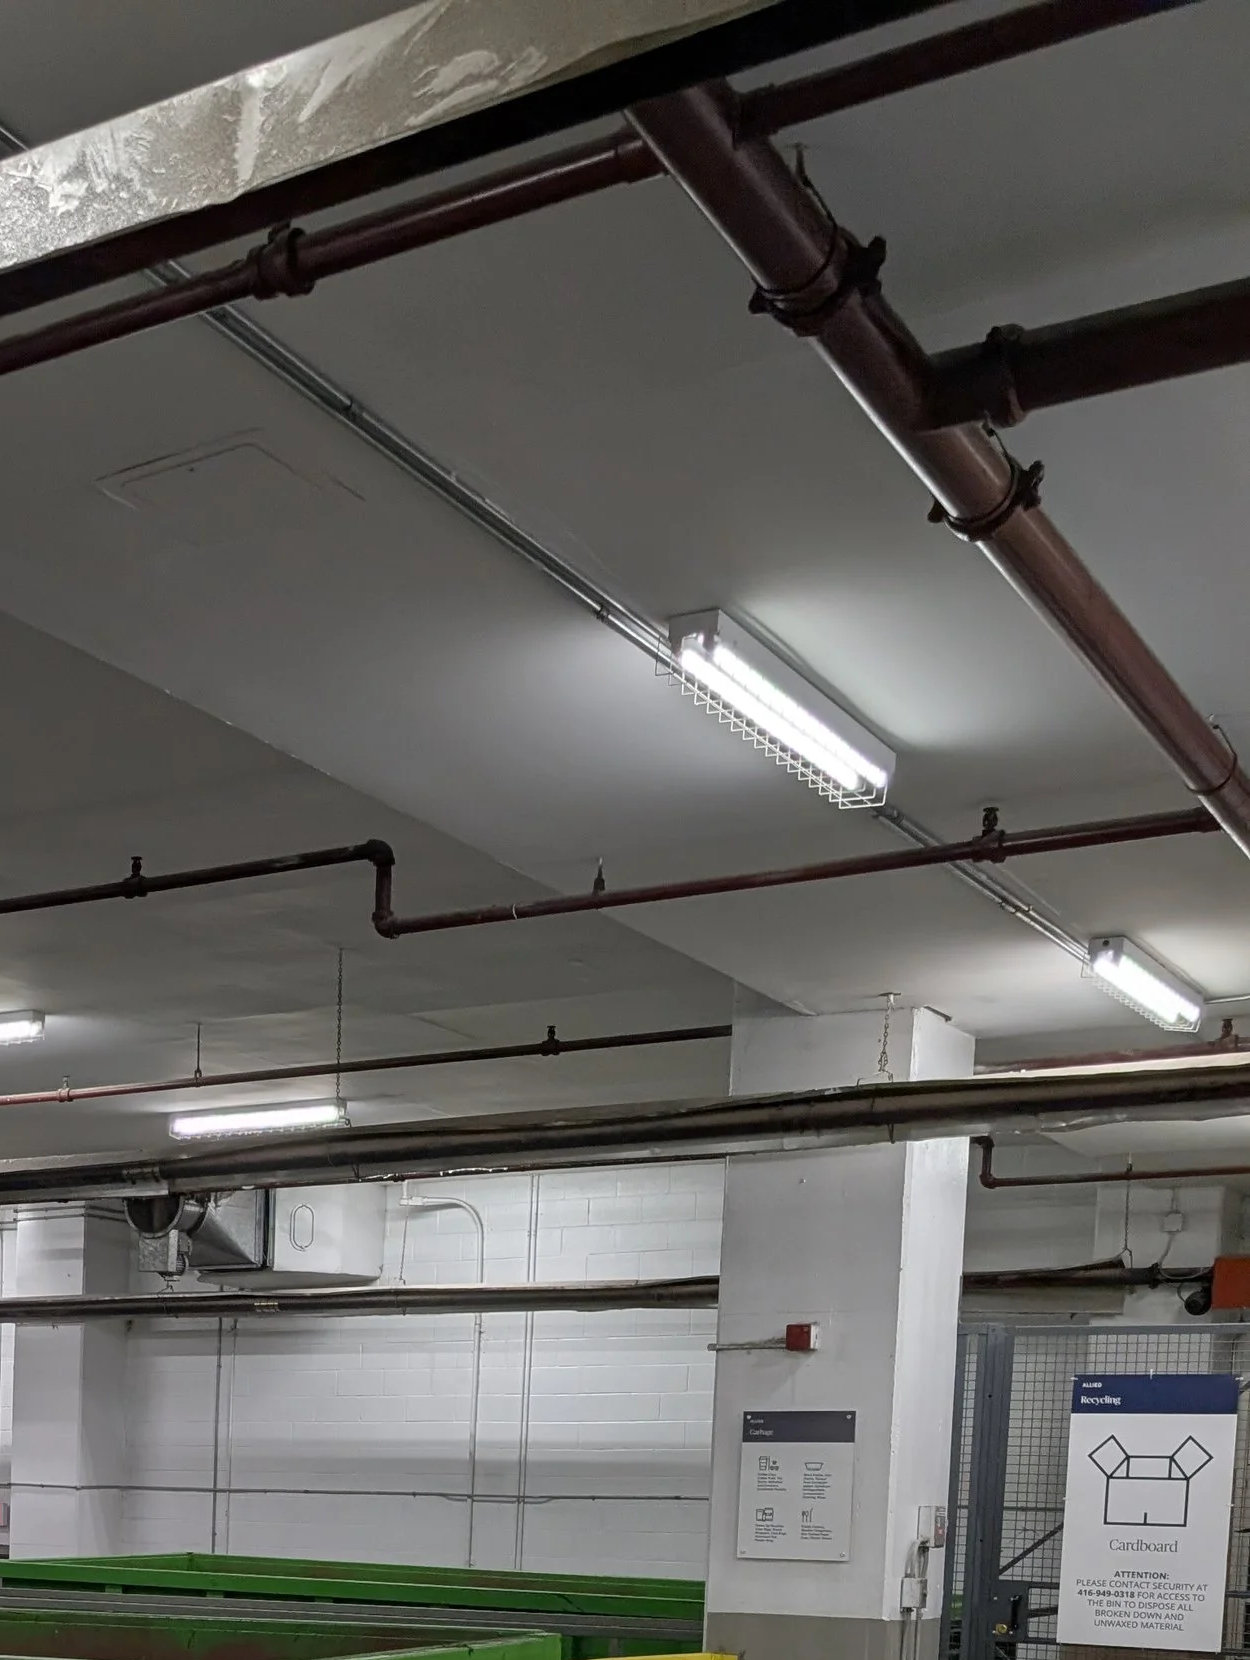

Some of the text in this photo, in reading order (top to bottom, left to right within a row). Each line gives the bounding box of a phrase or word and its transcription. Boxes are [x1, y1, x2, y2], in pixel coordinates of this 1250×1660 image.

[1080, 1395, 1121, 1406] Recycling
[1109, 1538, 1178, 1553] Cardboard
[1114, 1571, 1170, 1580] ATTENTION:
[1076, 1579, 1106, 1587] PLEASE
[1109, 1580, 1151, 1590] CONTACT
[1152, 1582, 1195, 1591] SECURITY
[1077, 1589, 1205, 1602] 416-949-0318 FOR ACCESS TO
[1087, 1599, 1194, 1612] THE BIN TO DISPOSE ALL
[1095, 1609, 1184, 1621] BROKEN DOWN AND
[1094, 1619, 1184, 1631] UNWAXED MATERIAL
